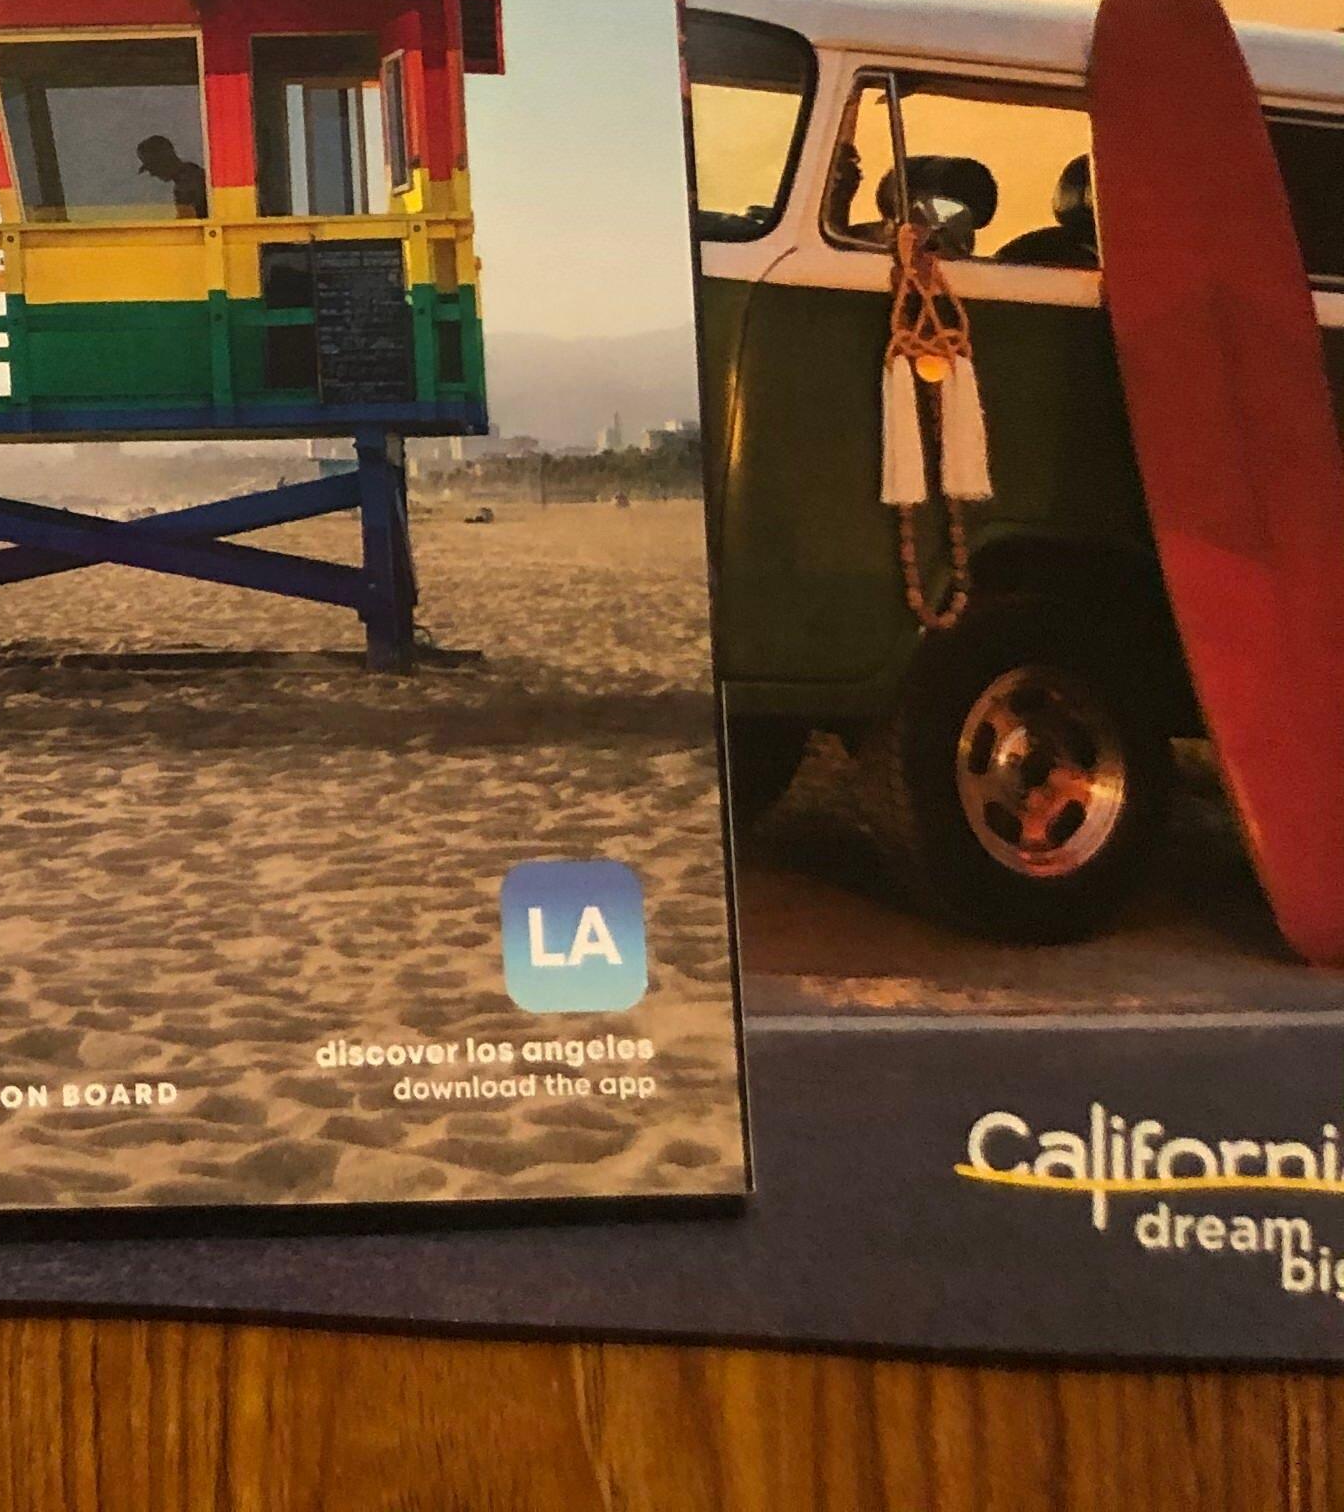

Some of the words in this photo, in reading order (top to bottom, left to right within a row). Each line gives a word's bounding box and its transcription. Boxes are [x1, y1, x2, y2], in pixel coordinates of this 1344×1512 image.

[527, 906, 623, 968] LA
[316, 1039, 460, 1068] discover
[465, 1037, 513, 1064] los
[521, 1034, 654, 1066] angeles
[62, 1082, 177, 1107] BOARD
[393, 1073, 536, 1101] download
[543, 1074, 591, 1097] the
[599, 1073, 656, 1101] app
[967, 1101, 1344, 1231] Californi
[1135, 1202, 1312, 1251] dream
